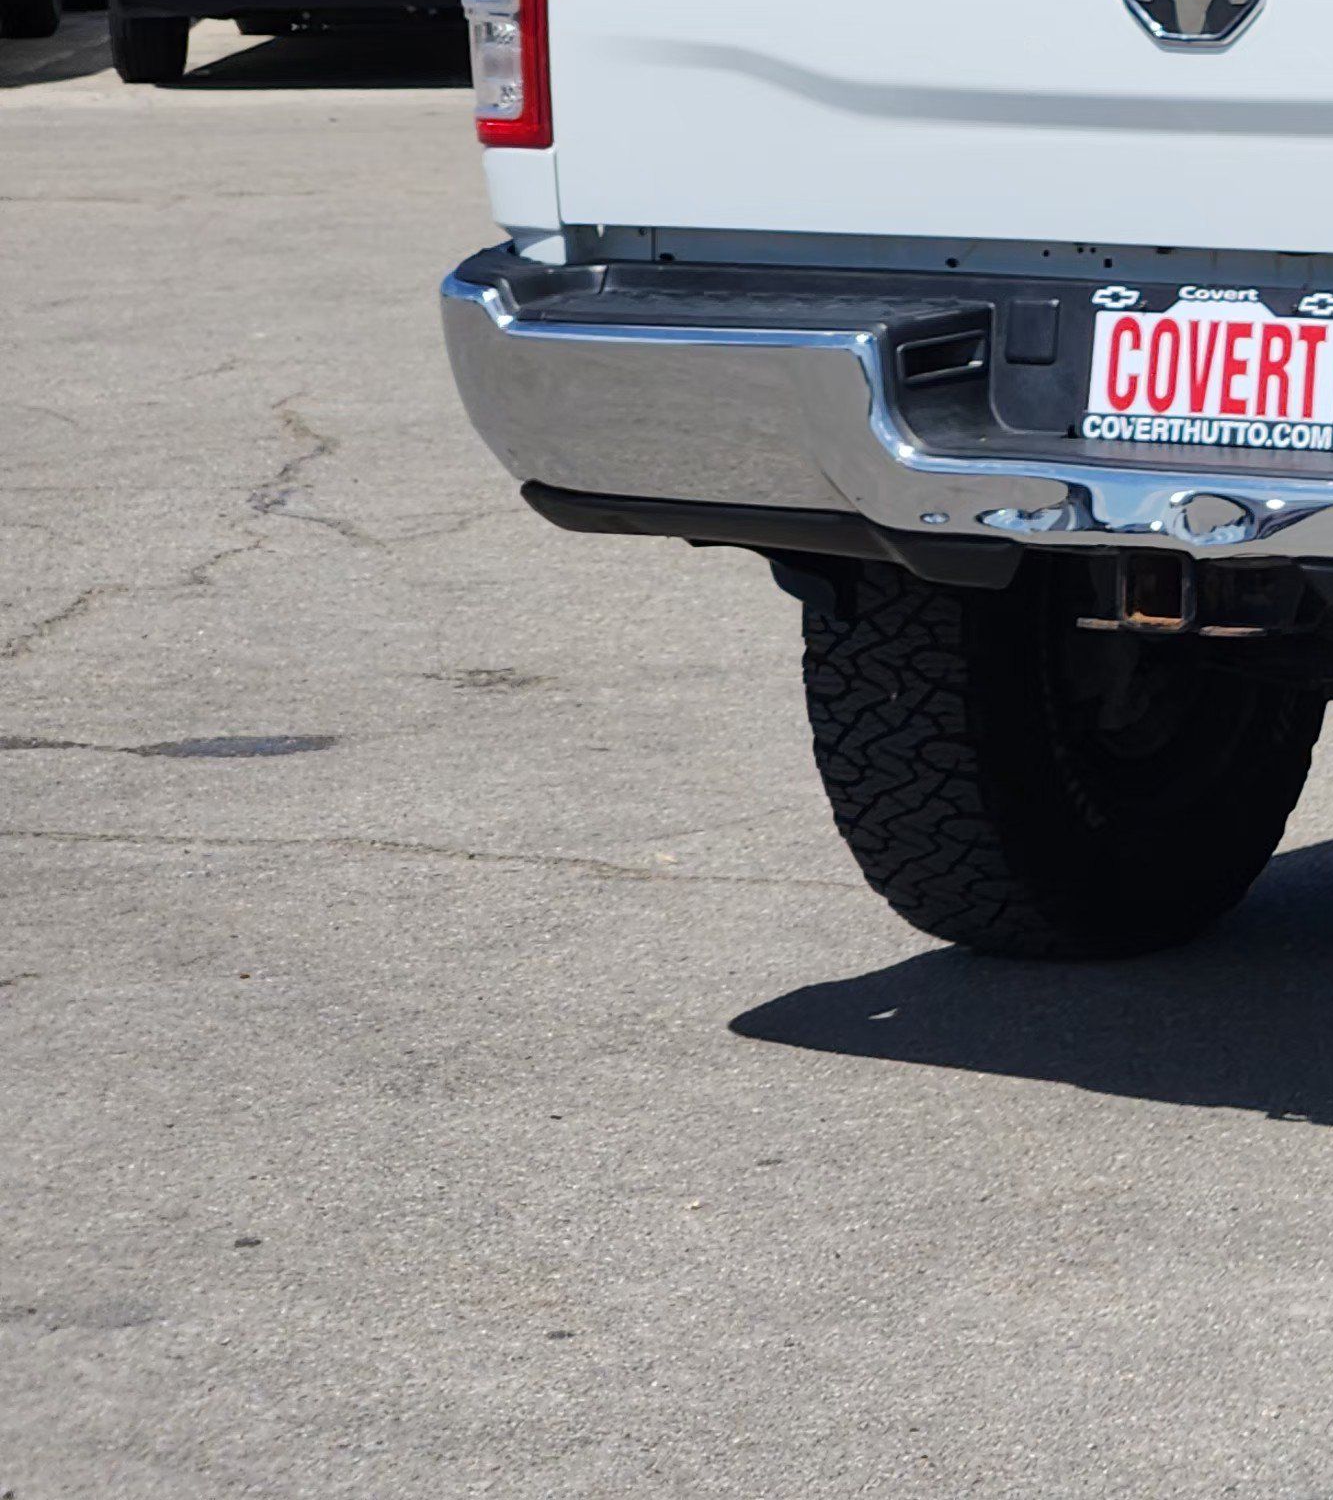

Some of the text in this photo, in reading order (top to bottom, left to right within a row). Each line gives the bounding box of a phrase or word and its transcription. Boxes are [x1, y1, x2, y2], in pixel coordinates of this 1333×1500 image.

[1178, 285, 1259, 301] Covert
[1107, 316, 1328, 419] COVERT
[1082, 414, 1333, 450] COVERTHUTTO.COM
